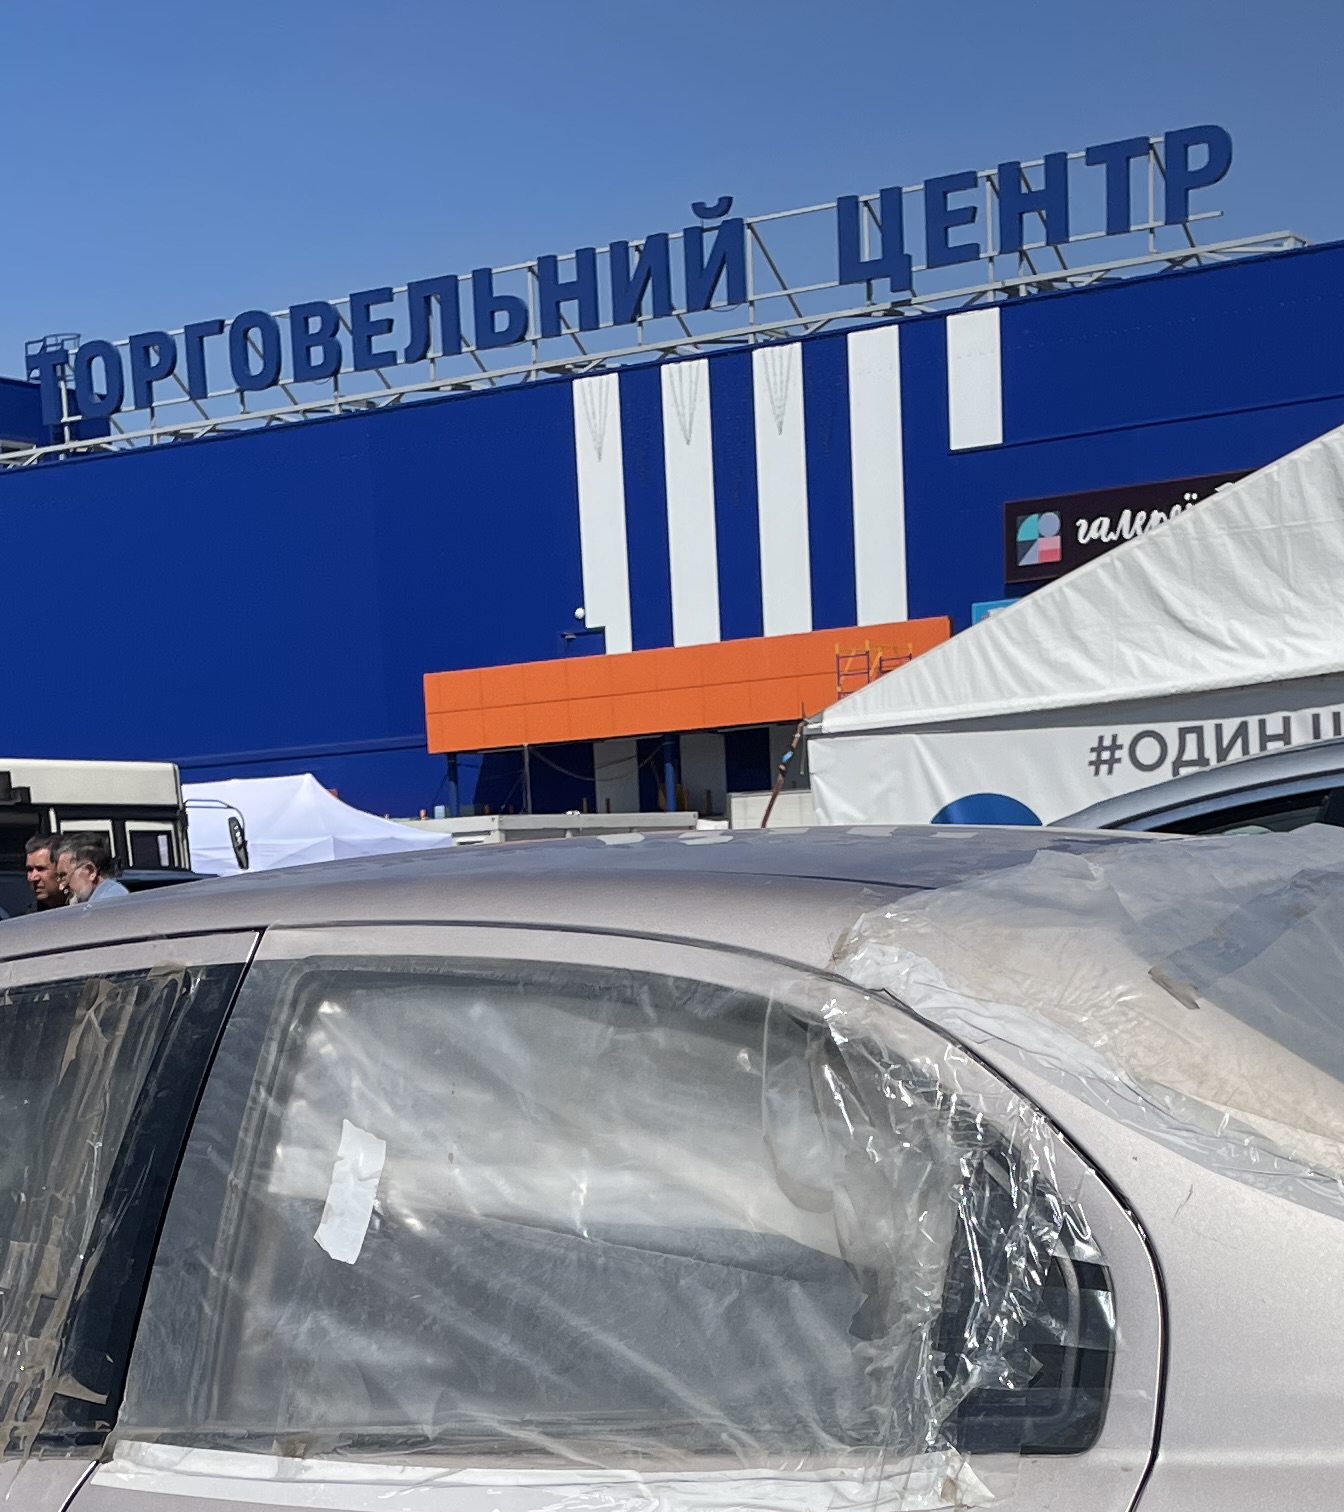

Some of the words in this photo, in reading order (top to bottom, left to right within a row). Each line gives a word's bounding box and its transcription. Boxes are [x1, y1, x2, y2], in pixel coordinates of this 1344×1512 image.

[29, 196, 747, 425] ТОРГОВЕЛЬНИЙ
[838, 125, 1233, 292] ЦЕНТР
[1088, 716, 1292, 777] #ОДИН
